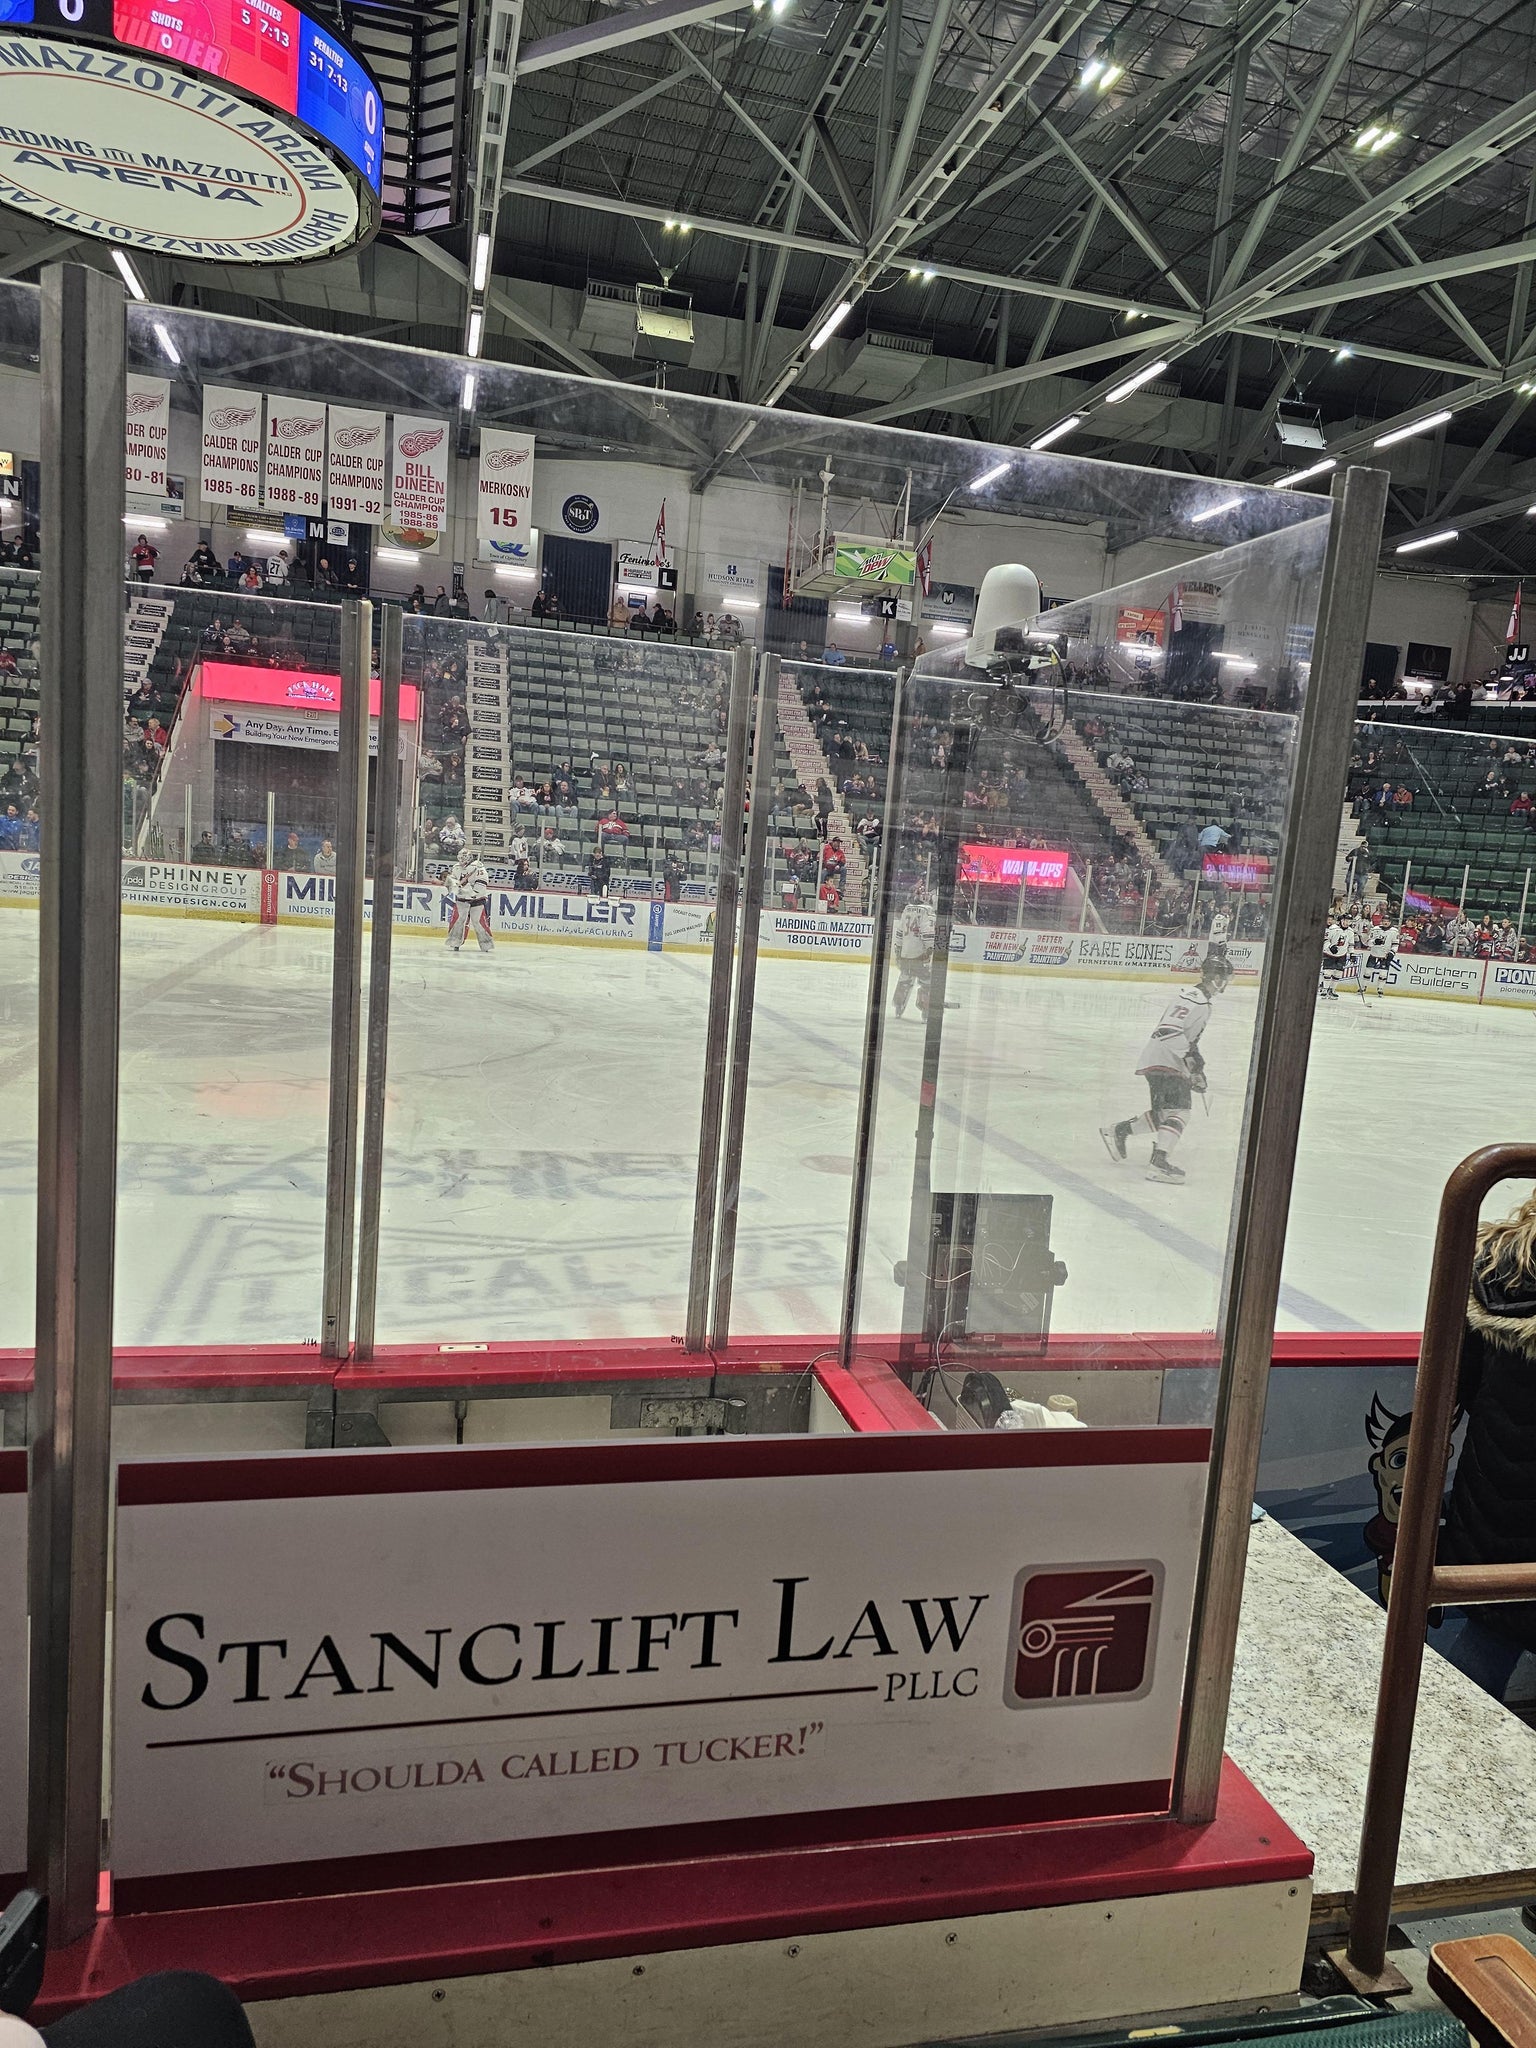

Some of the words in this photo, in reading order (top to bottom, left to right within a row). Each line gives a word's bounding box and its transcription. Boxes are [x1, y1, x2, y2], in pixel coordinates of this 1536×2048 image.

[150, 10, 183, 32] SHOTS
[241, 9, 251, 25] 5
[259, 19, 290, 47] 7:13
[161, 32, 173, 49] 0
[313, 36, 344, 69] PENALTIES
[309, 51, 323, 71] 31
[326, 65, 348, 93] 7:13
[0, 42, 240, 118] MAZZOTTI
[237, 121, 343, 190] ARENA
[0, 126, 96, 157] RDING
[142, 152, 289, 191] MAZZOTTI
[13, 150, 263, 207] ARENA
[44, 207, 242, 257] MAZZOTTI
[243, 208, 349, 257] HARDING
[149, 426, 167, 440] CUP
[204, 434, 237, 450] CALDER
[241, 439, 259, 453] CUP
[268, 443, 300, 459] CALDER
[305, 448, 322, 462] CUP
[203, 454, 259, 473] CHAMPIONS
[330, 453, 363, 469] CALDER
[367, 458, 383, 471] CUP
[405, 462, 435, 479] BILL
[267, 462, 321, 481] CHAMPIONS
[4, 480, 19, 496] N
[330, 472, 383, 491] CHAMPIONS
[395, 475, 445, 495] DINEEN
[480, 480, 530, 499] MERKOSKY
[393, 491, 426, 503] CALDER
[428, 494, 445, 505] CUP
[393, 500, 445, 513] CHAMPION
[399, 510, 438, 521] 1985-86
[489, 507, 518, 527] 15
[309, 522, 324, 538] M
[620, 553, 671, 568] Fenimoe's
[270, 563, 281, 585] 27
[662, 572, 672, 586] L
[708, 573, 734, 582] HUDSON
[1184, 582, 1222, 598] ELLER'S
[882, 601, 893, 614] K
[1508, 648, 1527, 661] JJ
[287, 681, 308, 693] JACK
[311, 681, 335, 697] HALL
[246, 720, 264, 730] Any
[266, 722, 285, 733] Day.
[287, 725, 304, 735] Any
[306, 726, 332, 737] Time.
[245, 730, 271, 741] Building
[272, 732, 287, 741] Your
[288, 734, 303, 742] New
[304, 736, 339, 747] Emergency
[150, 867, 247, 886] PHINNEY
[1002, 860, 1063, 877] WAM-UPS
[127, 876, 143, 887] pdg
[122, 893, 247, 909] PHINNEYDESIGN.COM
[287, 876, 432, 911] MILER
[289, 905, 334, 916] INDUSTRI
[499, 893, 635, 925] MILLER
[776, 918, 816, 931] HARDING
[787, 934, 862, 948] 1800LAW1010
[990, 932, 1017, 940] BETTER
[1037, 935, 1063, 944] BETTER
[985, 942, 1001, 950] THAN
[1003, 943, 1018, 951] NEW
[1031, 945, 1048, 953] THAN
[1050, 946, 1065, 954] NEW
[1079, 940, 1121, 958] BARE
[1125, 942, 1173, 961] BONES
[986, 952, 1015, 961] PAINTING
[1078, 958, 1123, 966] FURNITURE
[1131, 961, 1171, 969] MATTRESS
[1406, 964, 1477, 979] Northern
[1496, 969, 1536, 985] PION
[1410, 976, 1469, 989] Builders
[142, 1612, 738, 1710] STANCLIFT
[768, 1577, 989, 1664] LAW
[884, 1668, 979, 1702] PLLC
[268, 1758, 484, 1800] “SHOULDA
[501, 1744, 639, 1780] CALLED
[654, 1721, 826, 1768] TUCKER!”
